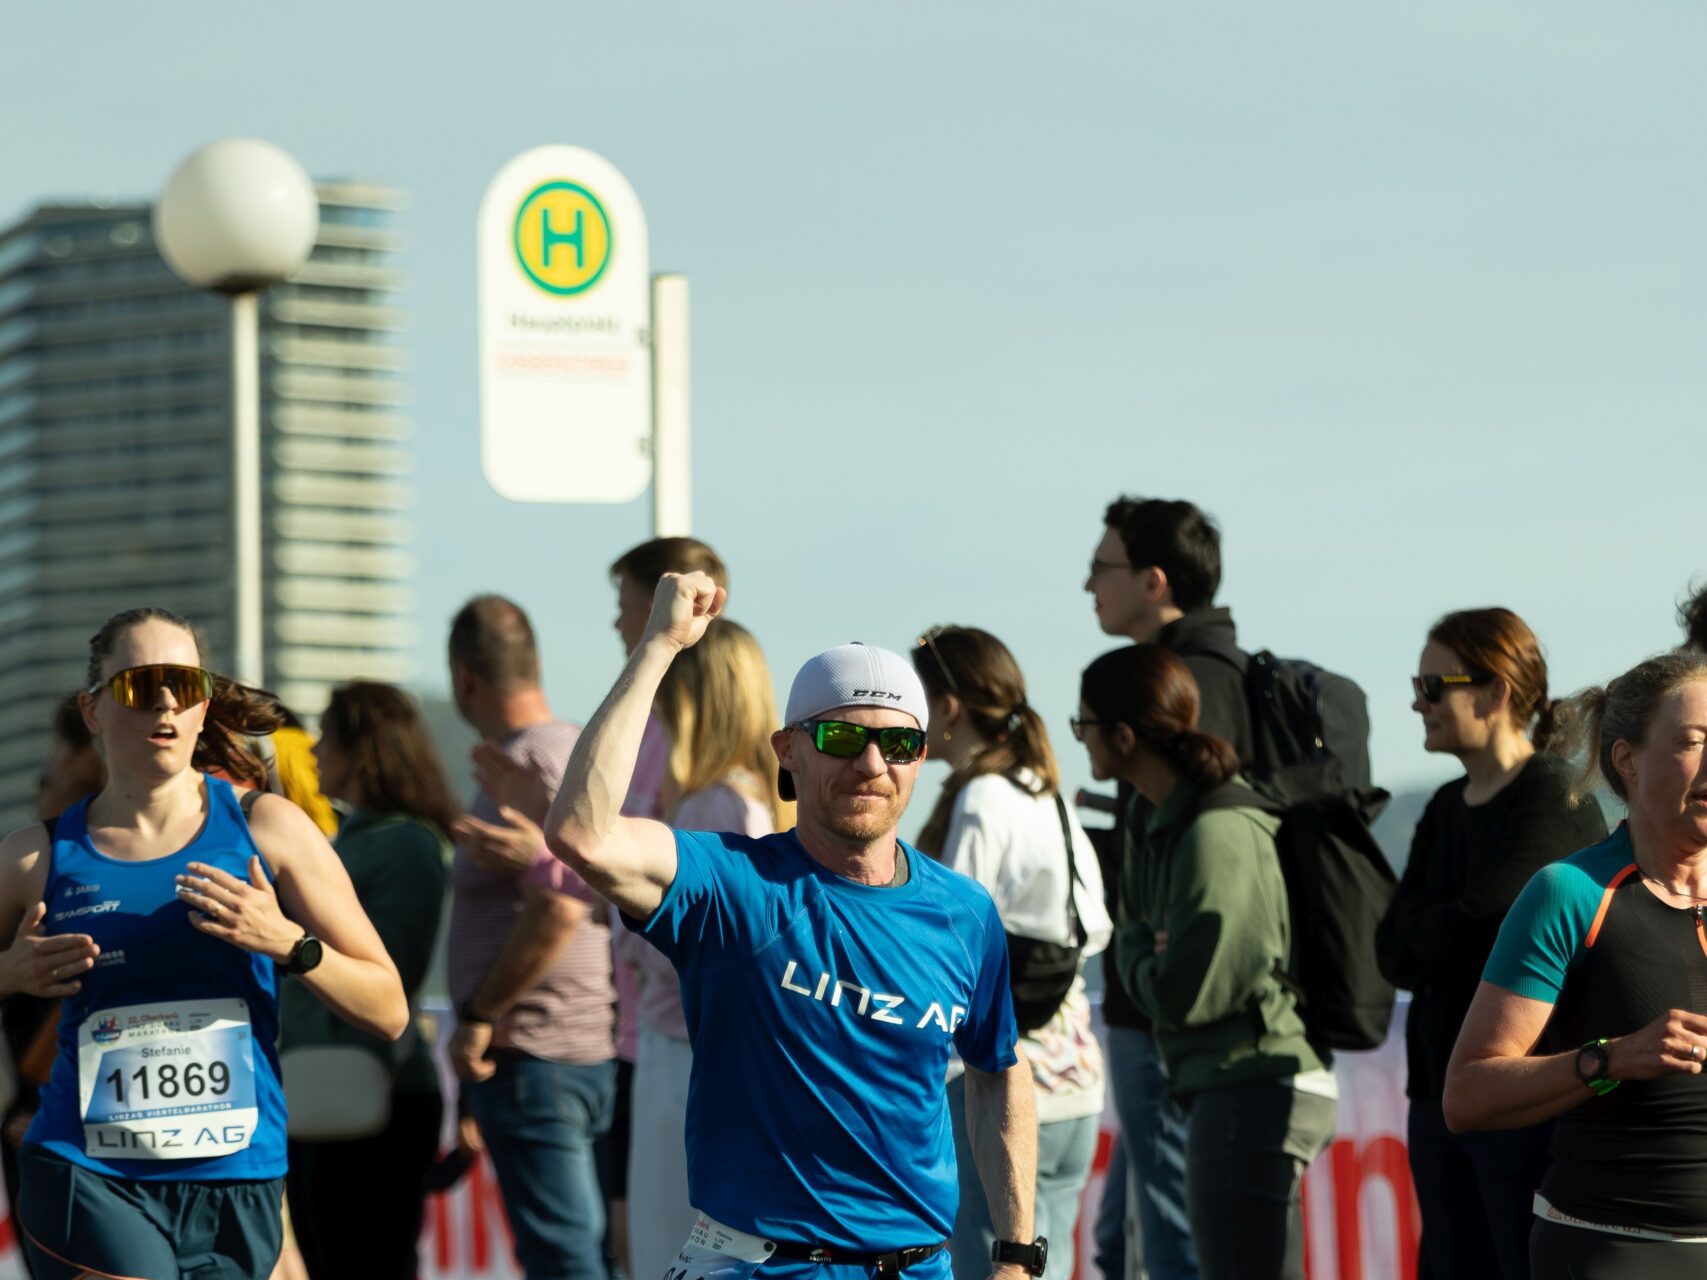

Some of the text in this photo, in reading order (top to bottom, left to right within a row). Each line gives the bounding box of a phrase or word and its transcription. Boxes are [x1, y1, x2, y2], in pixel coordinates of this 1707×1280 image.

[543, 208, 583, 268] H
[852, 689, 902, 702] CCM
[141, 1045, 192, 1059] Stefanie
[106, 1061, 231, 1102] 11869
[98, 1125, 246, 1149] LINZ AG
